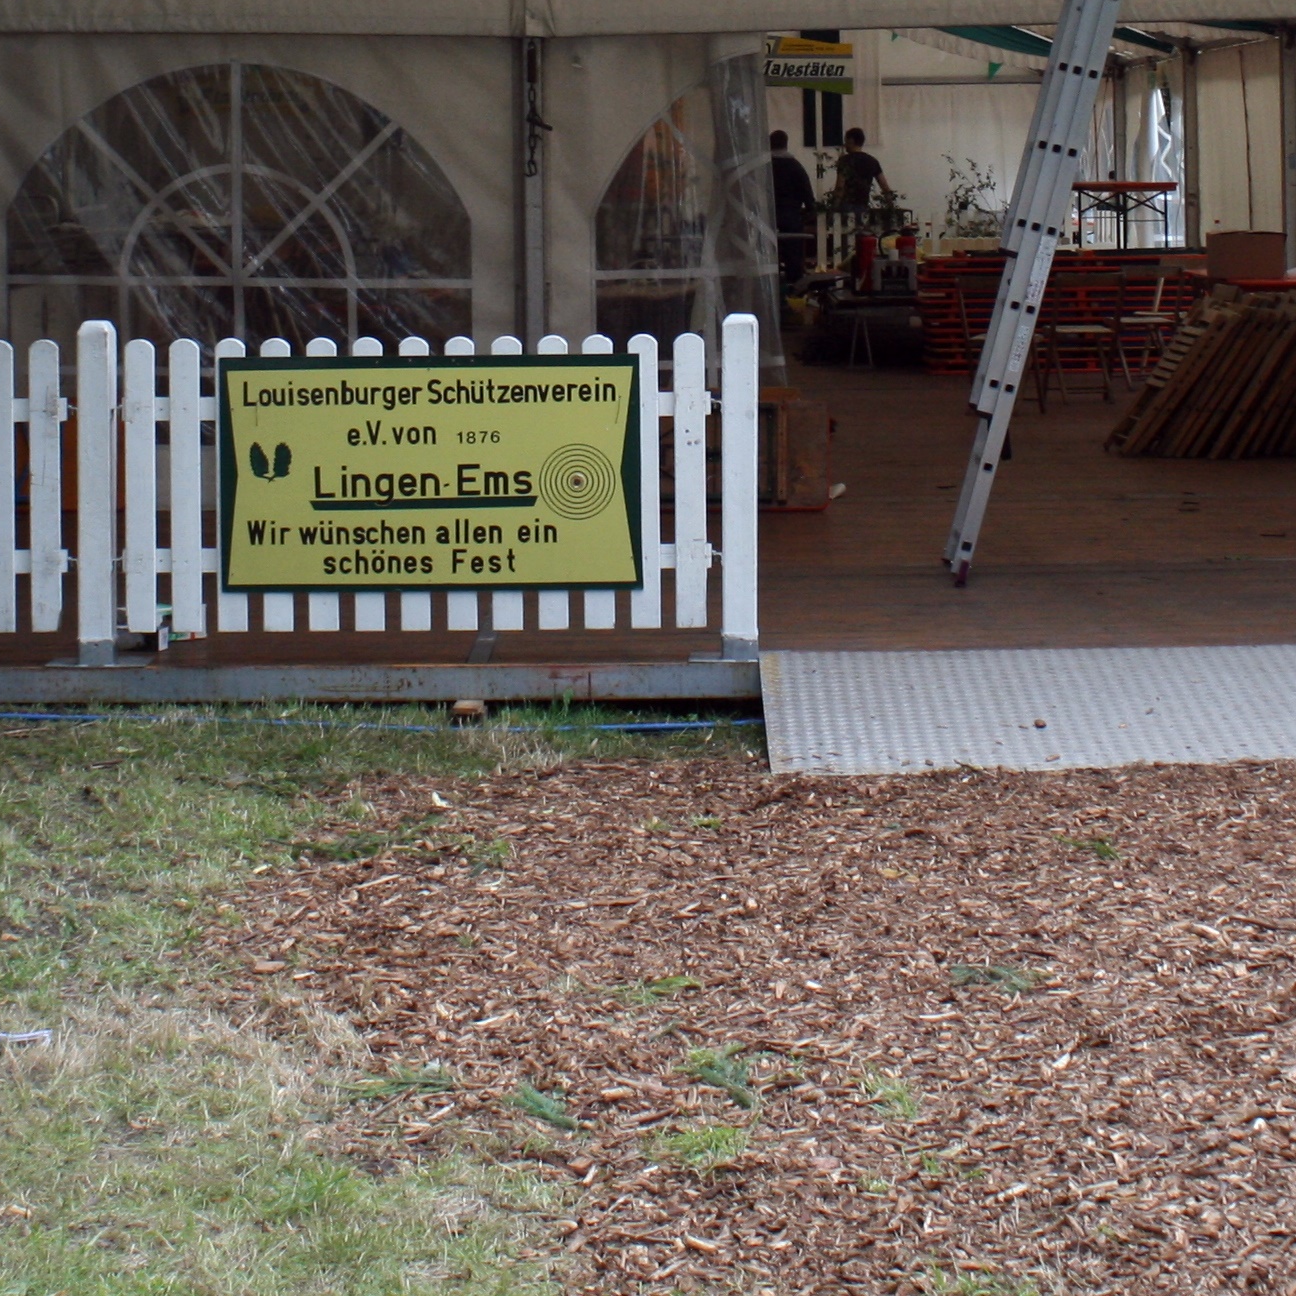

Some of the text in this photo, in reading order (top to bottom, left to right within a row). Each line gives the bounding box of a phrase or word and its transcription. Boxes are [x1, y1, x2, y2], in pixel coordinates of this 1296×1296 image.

[242, 377, 616, 410] Louisenburger Schützenverein
[456, 430, 501, 444] 1876
[247, 518, 558, 546] Wir wünschen allen ein
[323, 548, 516, 575] schönes Fest
